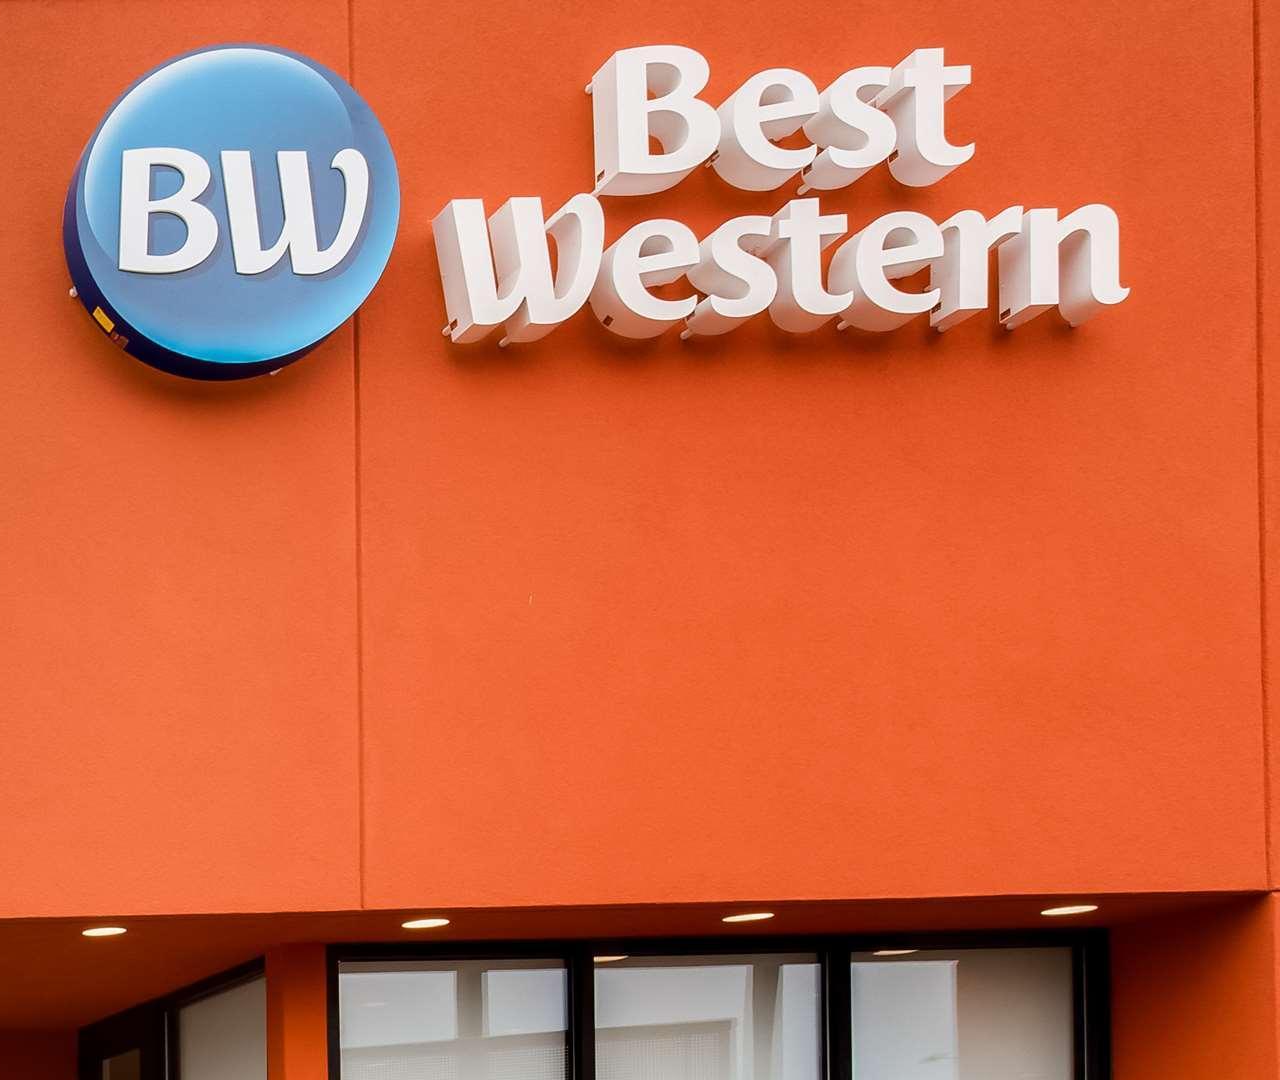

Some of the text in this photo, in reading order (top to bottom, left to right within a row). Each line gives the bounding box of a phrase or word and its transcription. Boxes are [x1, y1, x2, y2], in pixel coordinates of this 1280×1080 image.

[614, 44, 976, 178] Best
[119, 146, 369, 275] BW
[448, 193, 1131, 328] Western
